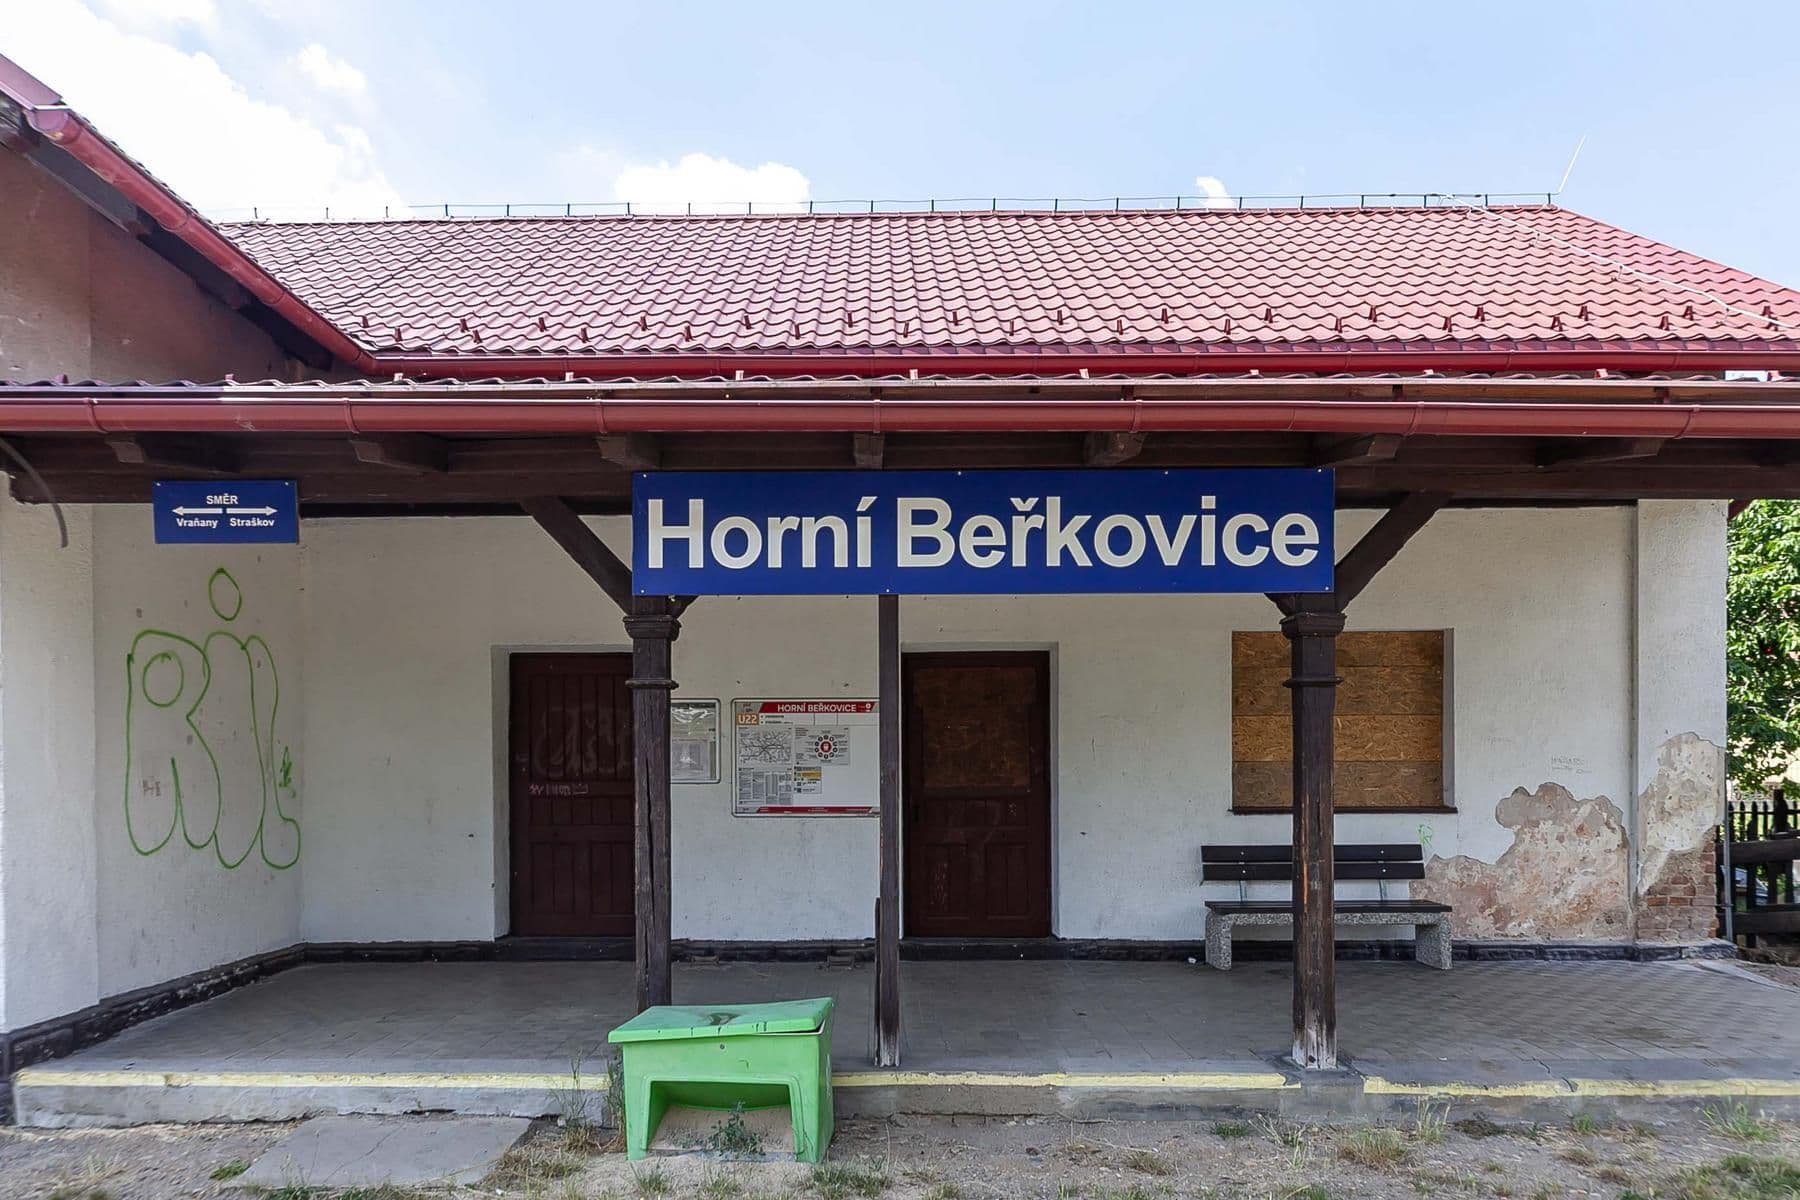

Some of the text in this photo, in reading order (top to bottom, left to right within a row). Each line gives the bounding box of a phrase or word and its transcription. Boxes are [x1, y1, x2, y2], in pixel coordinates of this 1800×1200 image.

[206, 493, 239, 505] SMĚR
[176, 517, 275, 529] Vraňany Straškov
[647, 496, 1320, 569] Horní Beřkovice
[777, 702, 857, 712] HORNÍ BEŘKOVICE
[738, 714, 757, 724] U22
